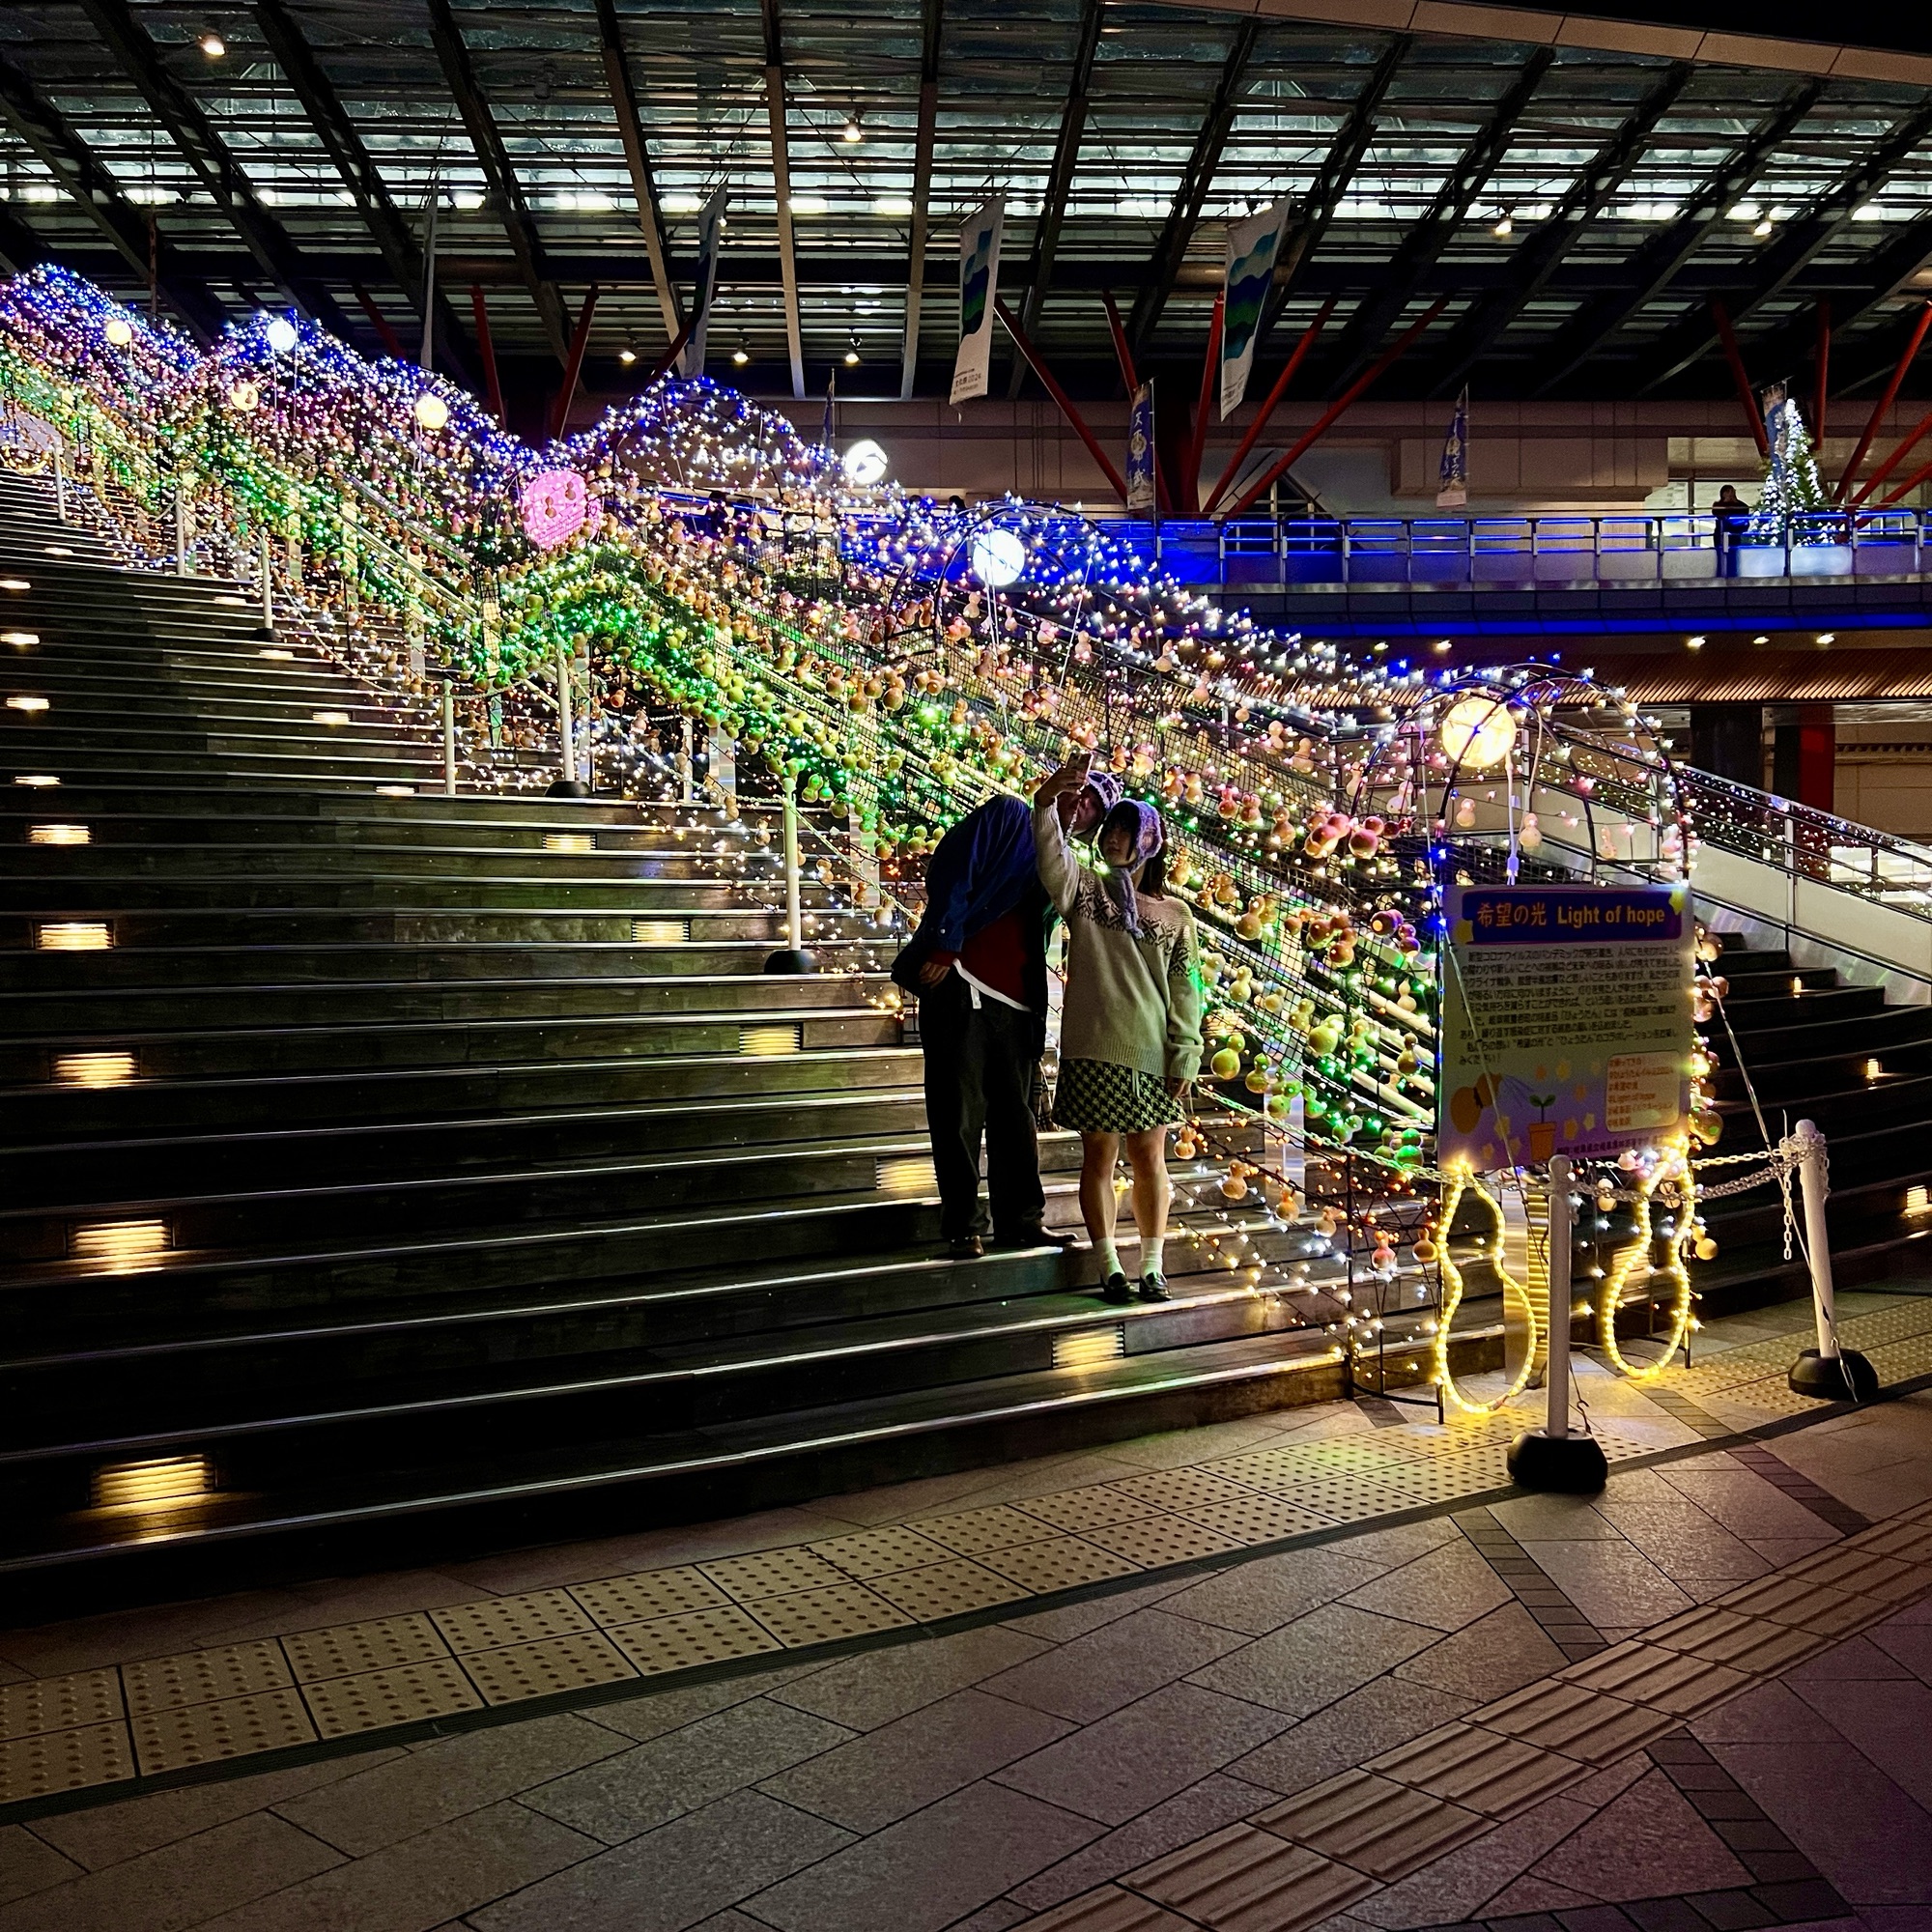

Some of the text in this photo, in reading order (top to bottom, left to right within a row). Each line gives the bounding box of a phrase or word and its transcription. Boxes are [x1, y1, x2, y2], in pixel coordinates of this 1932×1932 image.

[1477, 901, 1664, 928] 希望の光 Light of hope
